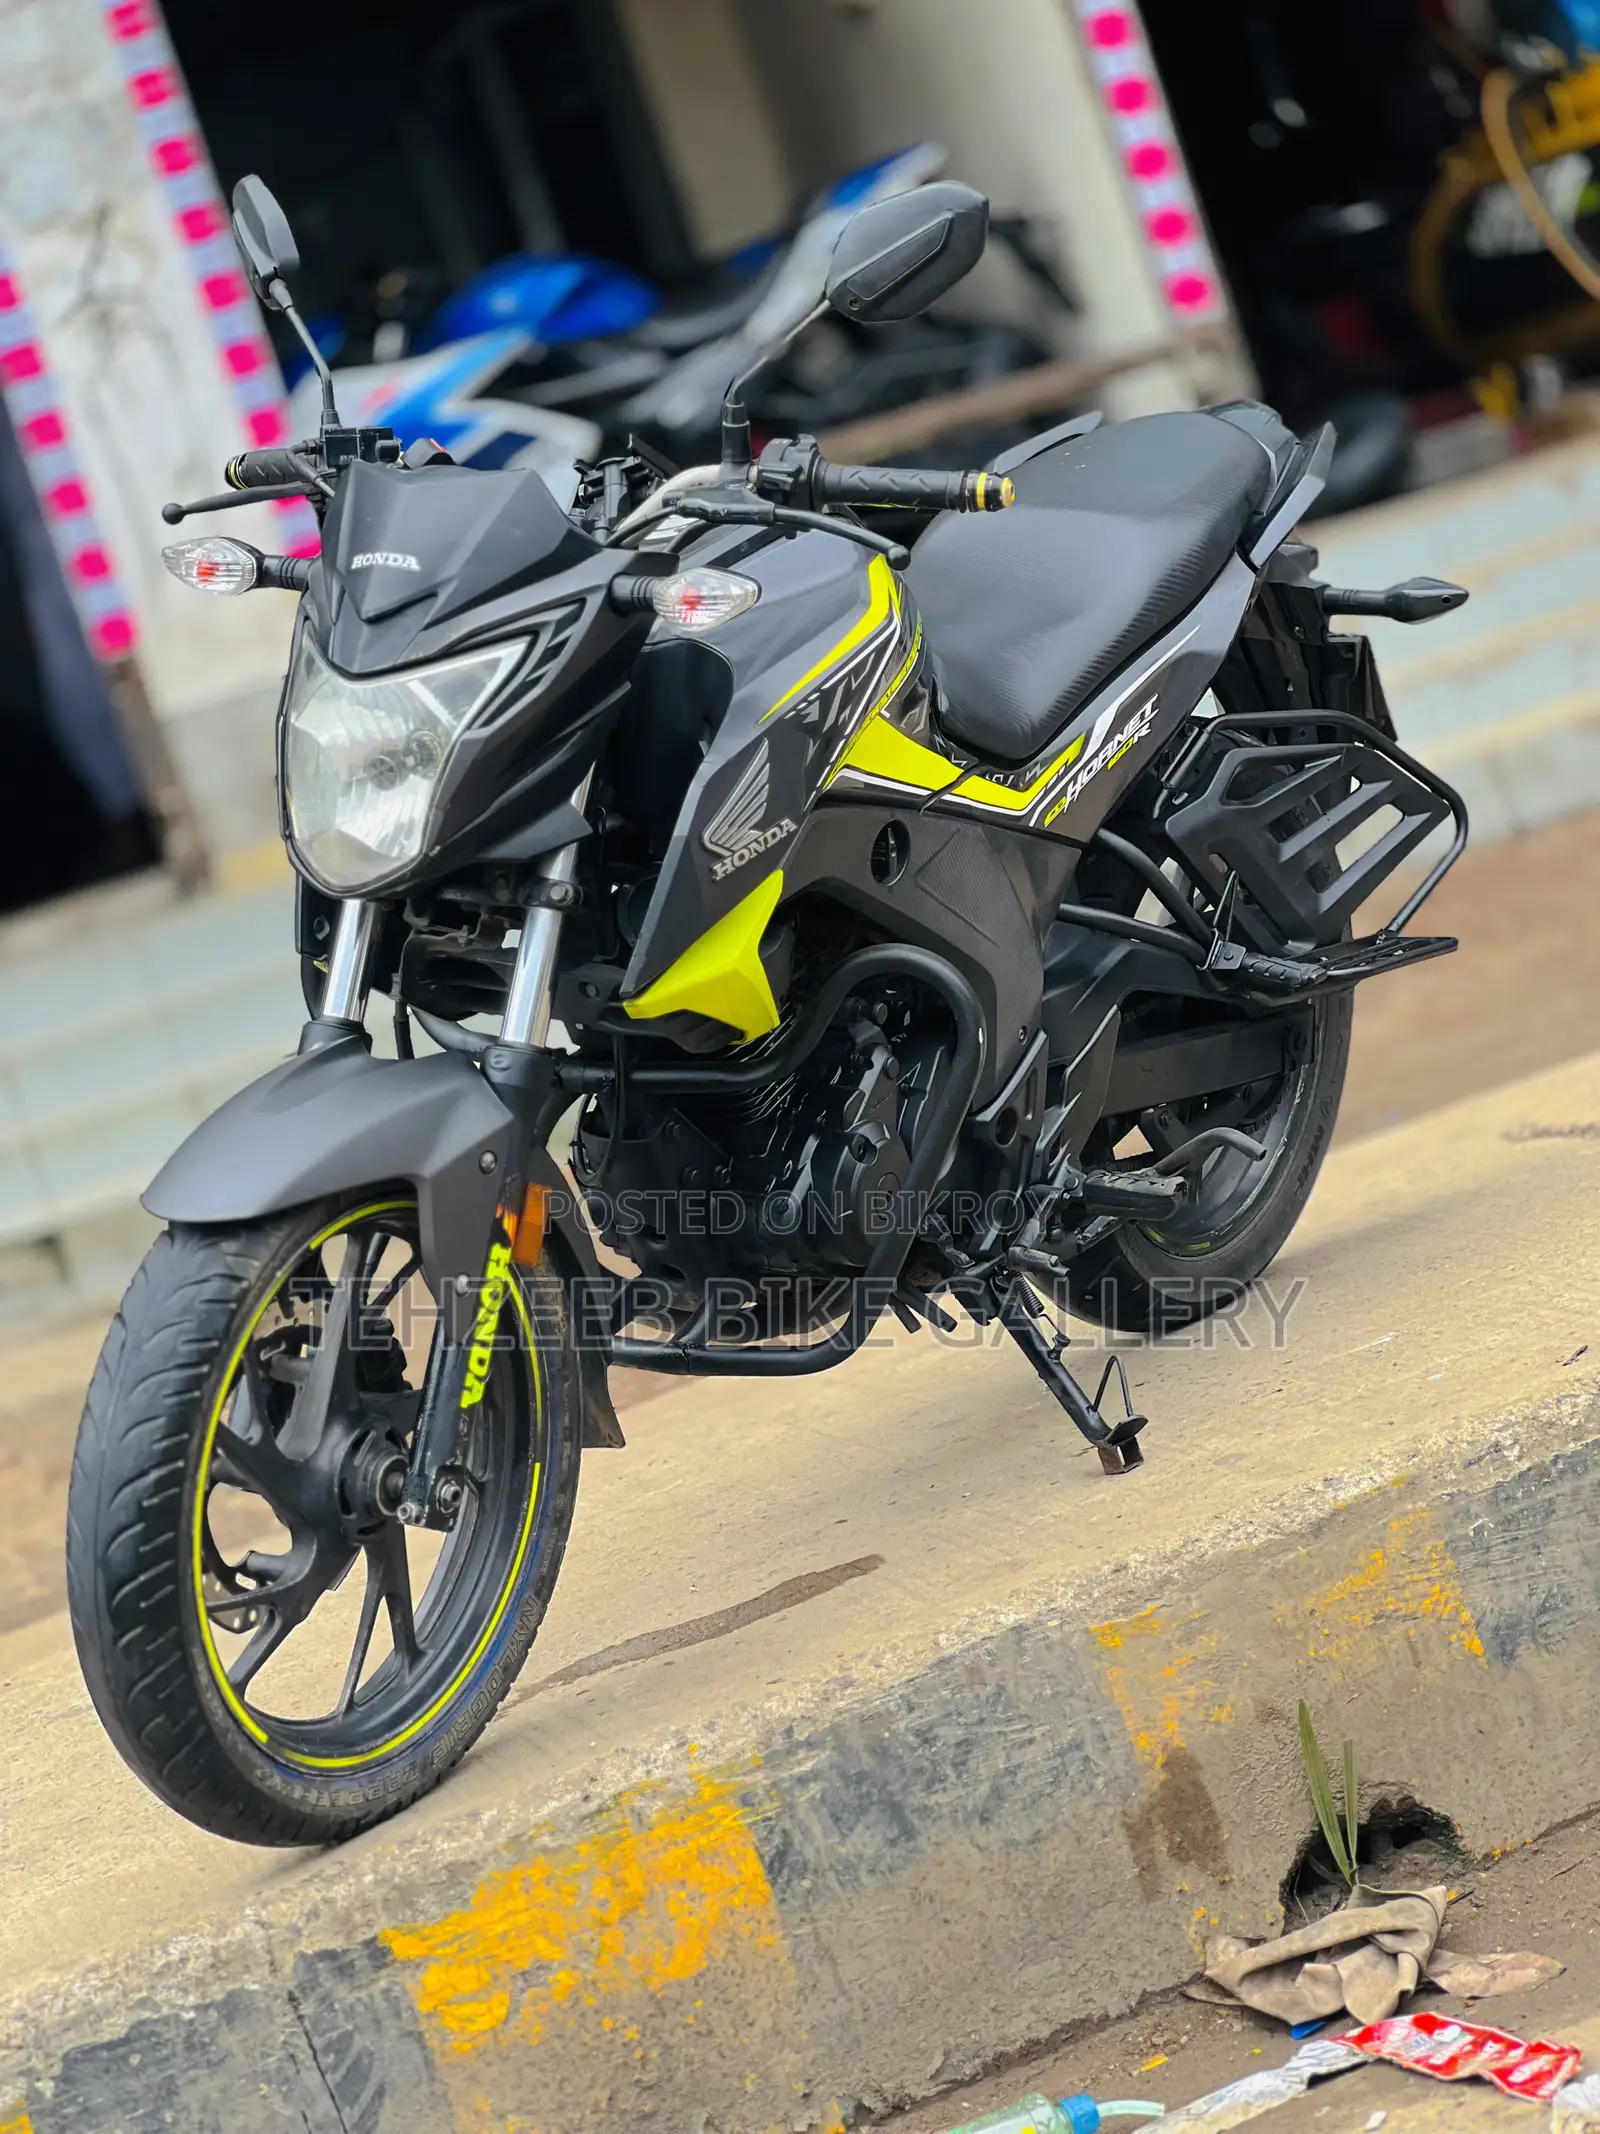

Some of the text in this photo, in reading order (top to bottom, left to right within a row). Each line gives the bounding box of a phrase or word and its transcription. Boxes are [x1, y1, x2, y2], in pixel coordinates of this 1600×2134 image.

[351, 552, 421, 572] HONDA
[1063, 692, 1160, 814] HORNET
[710, 817, 799, 881] HONDA
[460, 1242, 512, 1409] HONDA
[430, 1594, 540, 1768] NYLOGRIP
